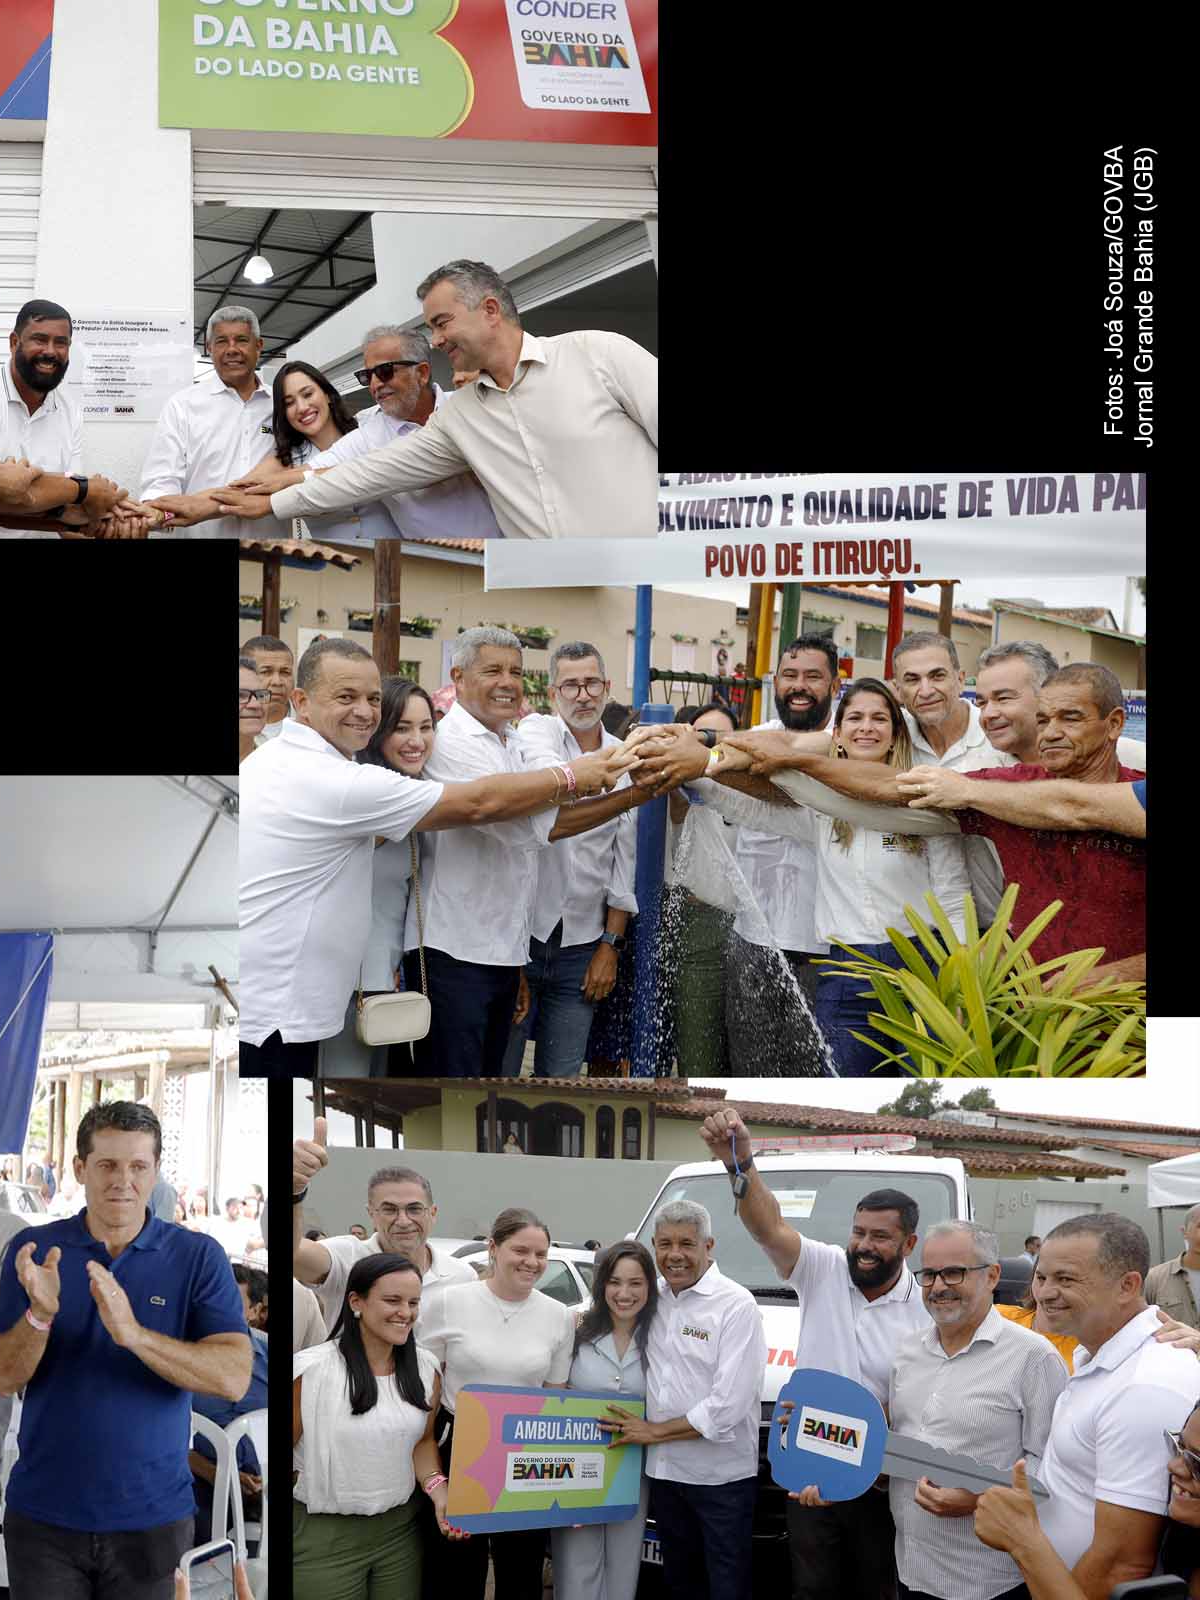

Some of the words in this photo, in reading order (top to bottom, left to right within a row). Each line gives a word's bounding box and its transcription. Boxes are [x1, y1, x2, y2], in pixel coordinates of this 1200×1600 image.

[516, 0, 617, 20] CONDER
[193, 14, 256, 48] DA
[266, 17, 399, 56] BAHIA
[521, 29, 598, 45] GOVERNO
[603, 34, 624, 46] DA
[523, 42, 630, 69] BAHIA
[194, 57, 232, 75] DO
[238, 58, 304, 78] LADO
[310, 62, 342, 80] DA
[347, 64, 420, 85] GENTE
[542, 95, 556, 104] DO
[558, 96, 584, 104] LADO
[588, 97, 600, 105] DA
[600, 98, 630, 106] GENTE
[780, 493, 794, 526] E
[803, 483, 948, 526] QUALIDADE
[958, 480, 994, 519] DE
[1006, 474, 1080, 516] VIDA
[705, 544, 766, 578] POVO
[775, 542, 804, 577] DE
[812, 538, 921, 580] ITIRUÇU.
[682, 1328, 709, 1342] BAHIA
[514, 1418, 602, 1440] AMBULÂNCIA
[803, 1418, 860, 1448] BAHIA
[513, 1463, 574, 1480] BAHIA
